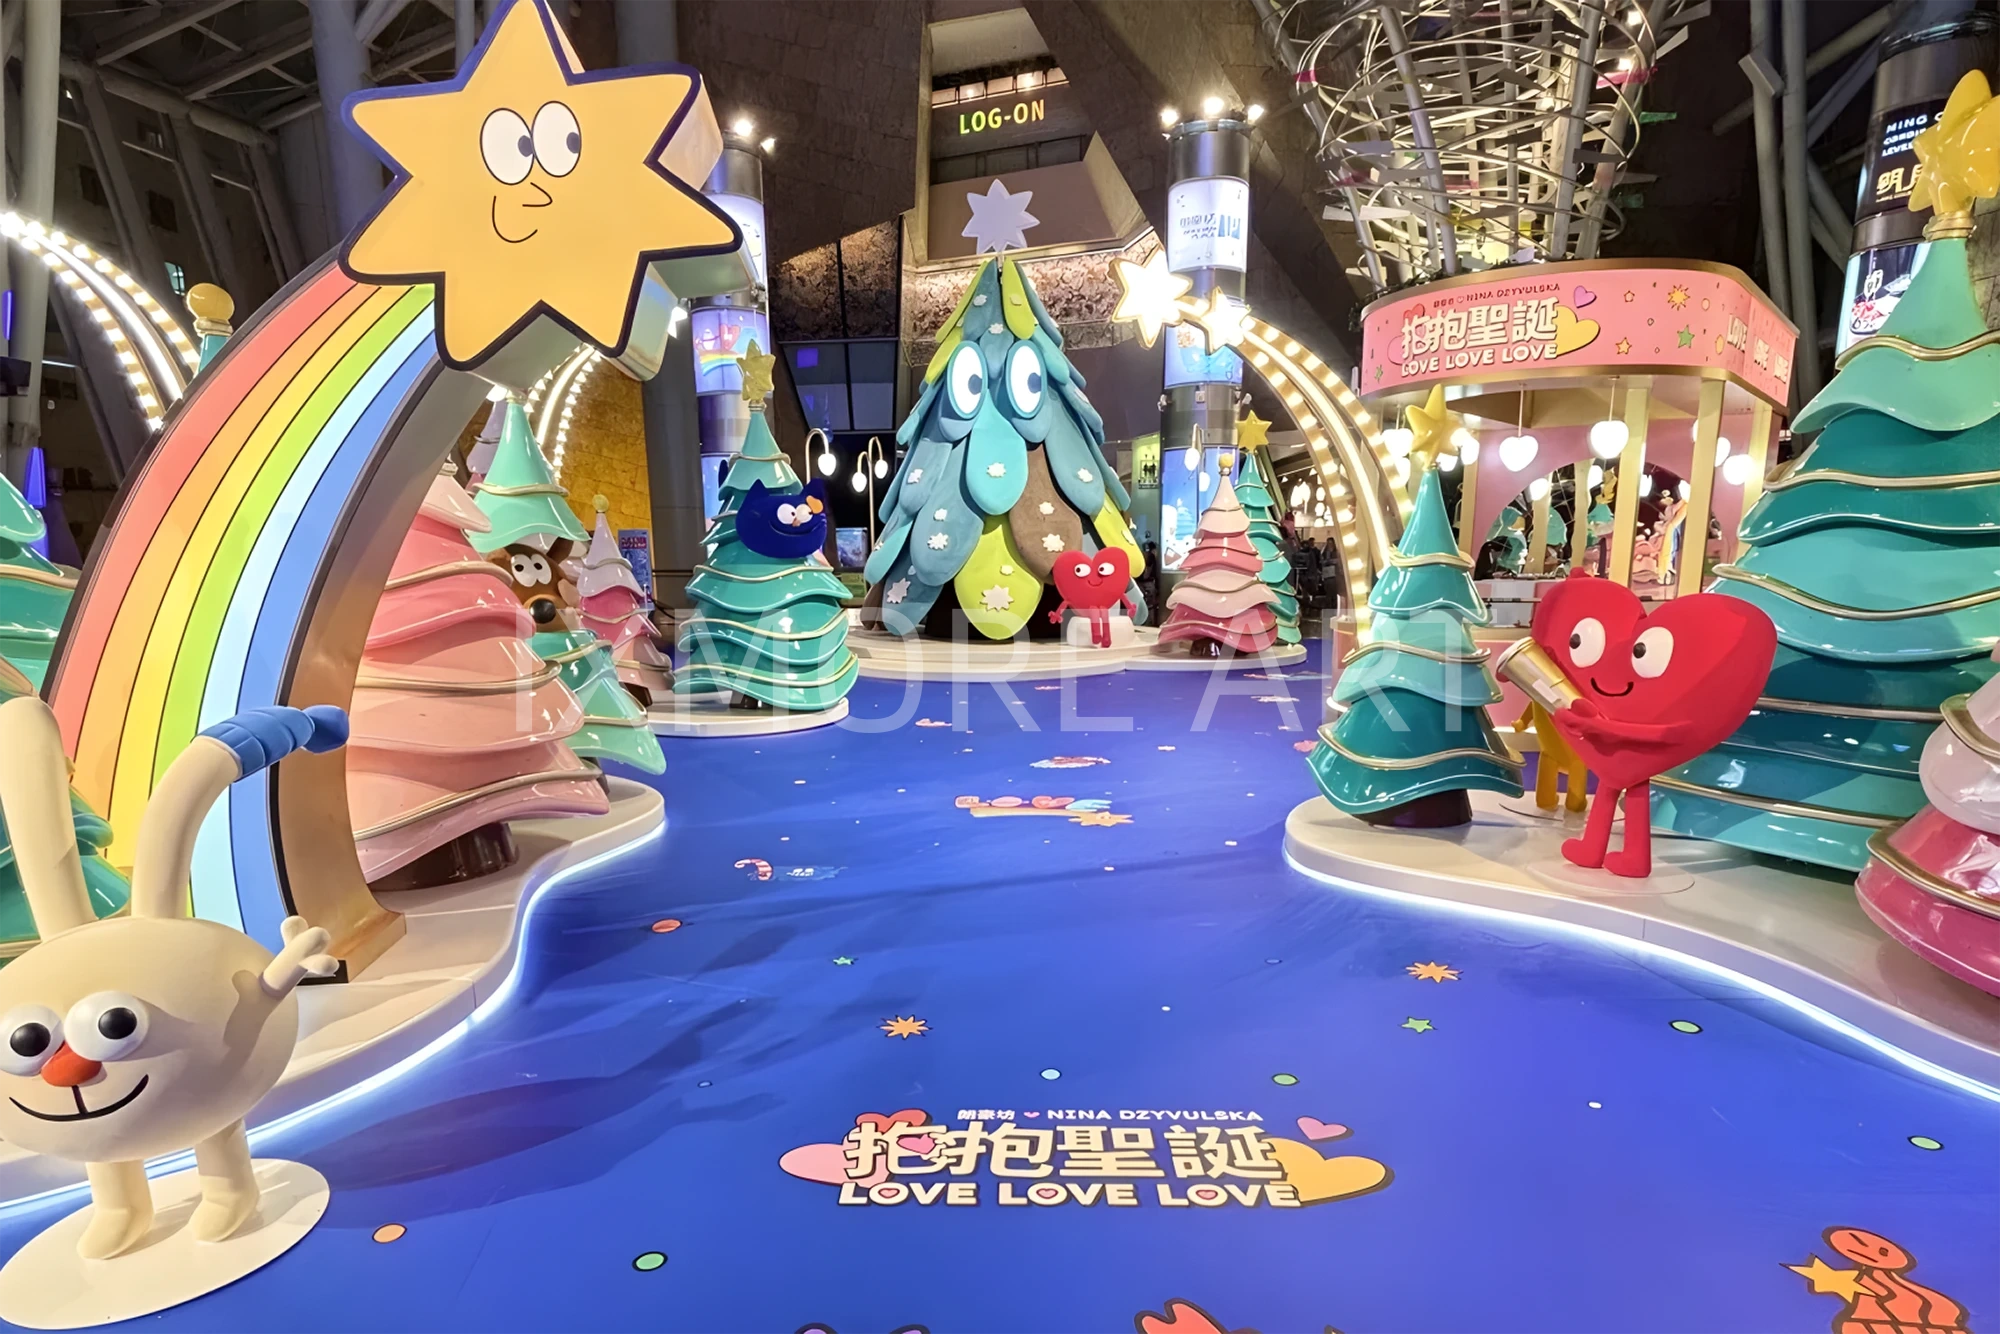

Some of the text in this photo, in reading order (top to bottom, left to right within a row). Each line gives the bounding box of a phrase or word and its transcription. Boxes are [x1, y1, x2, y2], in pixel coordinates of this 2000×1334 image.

[959, 99, 1044, 134] LOG-ON
[1401, 297, 1559, 358] 抱抱聖誕
[1401, 342, 1558, 378] LOVE LOVE LOVE
[1047, 1109, 1264, 1121] NINA DZYVULSKA
[843, 1121, 1283, 1179] 抱抱聖誕
[838, 1182, 1302, 1208] LOVE LOVE LOVE
